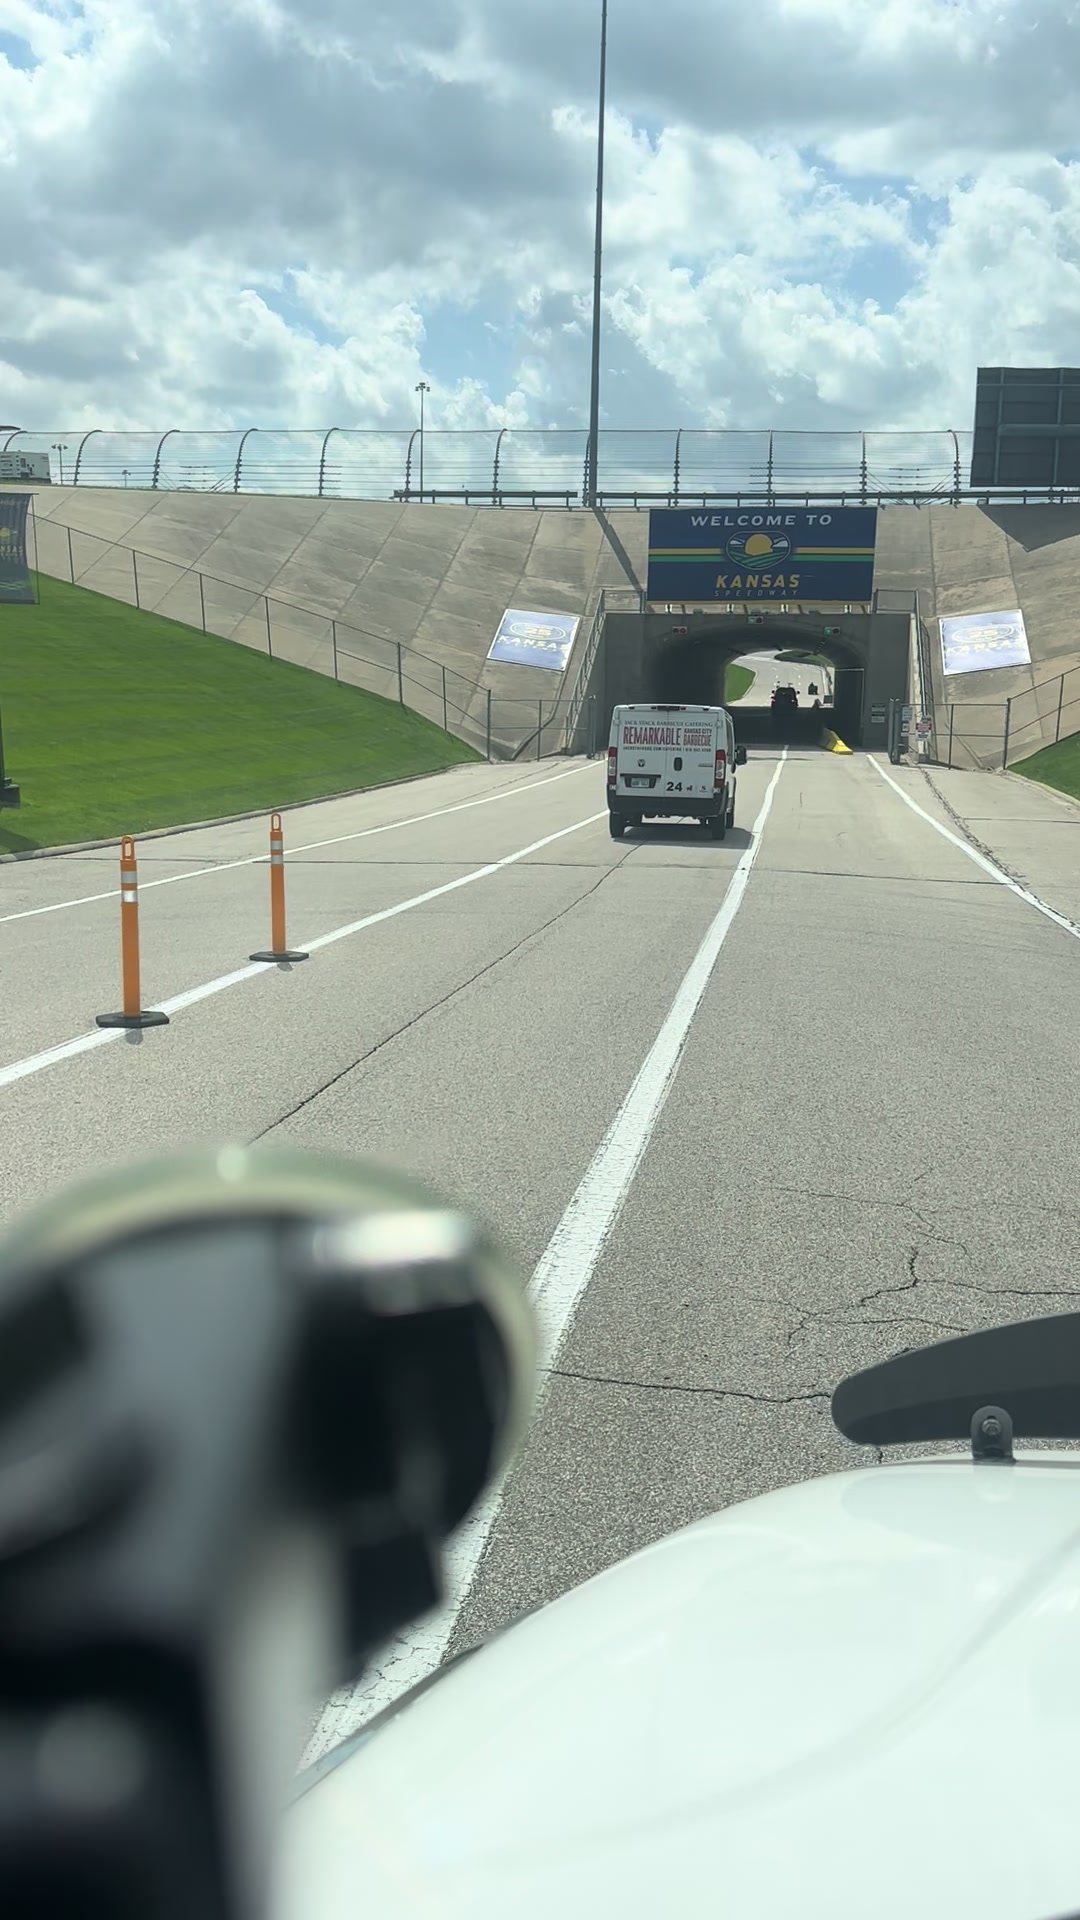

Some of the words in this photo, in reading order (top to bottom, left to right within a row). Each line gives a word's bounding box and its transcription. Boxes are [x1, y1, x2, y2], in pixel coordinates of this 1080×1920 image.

[690, 515, 797, 527] WELCOME
[806, 514, 832, 526] TO
[0, 545, 23, 554] NSAS
[715, 574, 800, 588] KANSAS
[714, 589, 799, 597] SPEEDWAY
[623, 726, 682, 746] REMARKABLE
[683, 734, 712, 747] BARBECUE
[666, 781, 683, 792] 24
